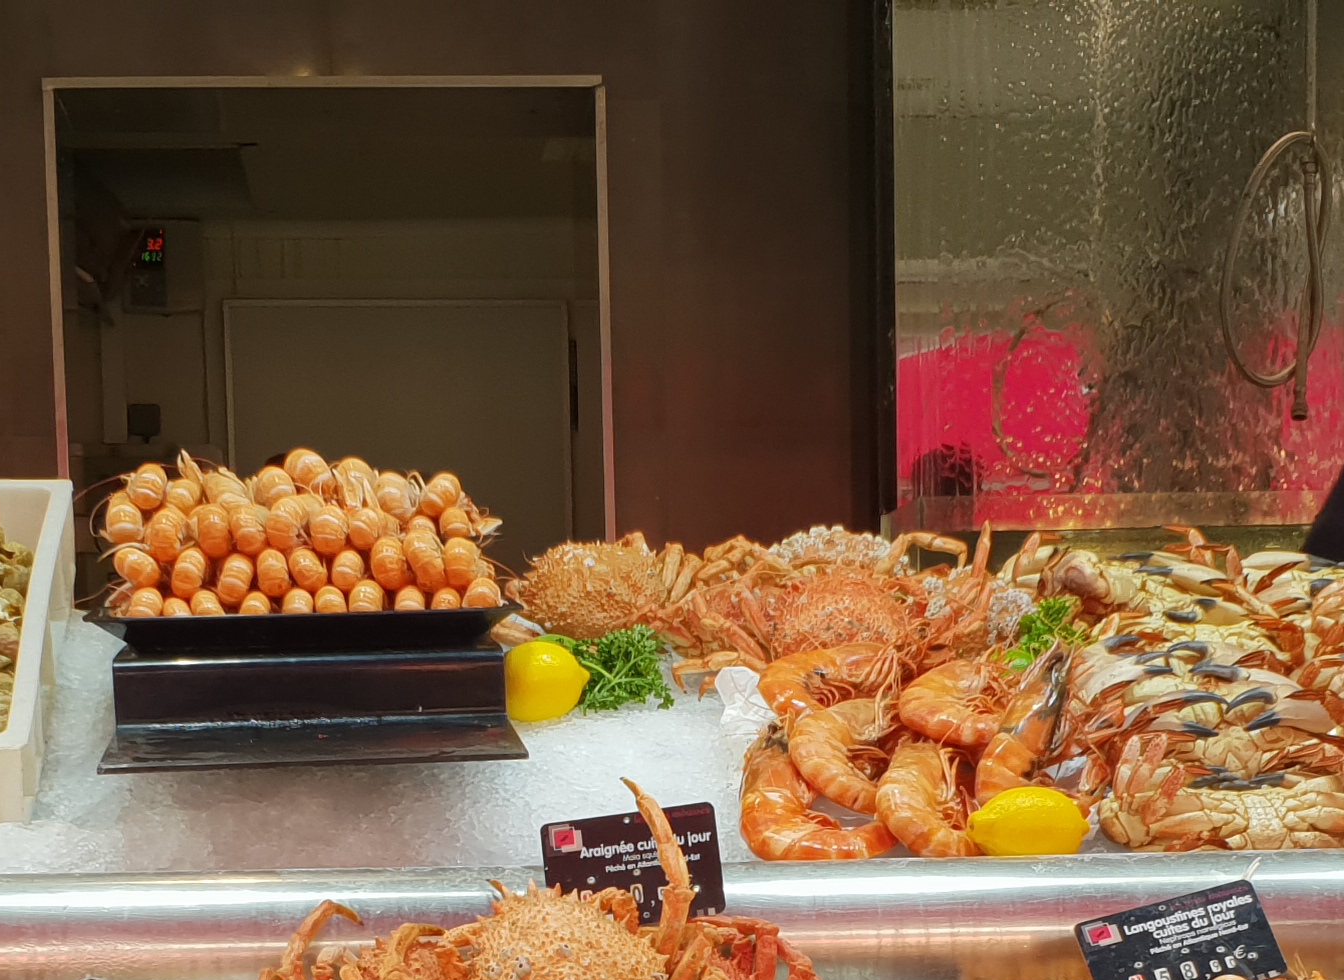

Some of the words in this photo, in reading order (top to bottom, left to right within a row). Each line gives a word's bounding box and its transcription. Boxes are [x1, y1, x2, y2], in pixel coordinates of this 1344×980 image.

[580, 841, 634, 859] Araignée
[687, 831, 711, 847] jour
[1123, 907, 1206, 936] Langoustines
[1207, 895, 1253, 913] royales
[1152, 922, 1190, 939] cuites
[1191, 916, 1208, 929] du
